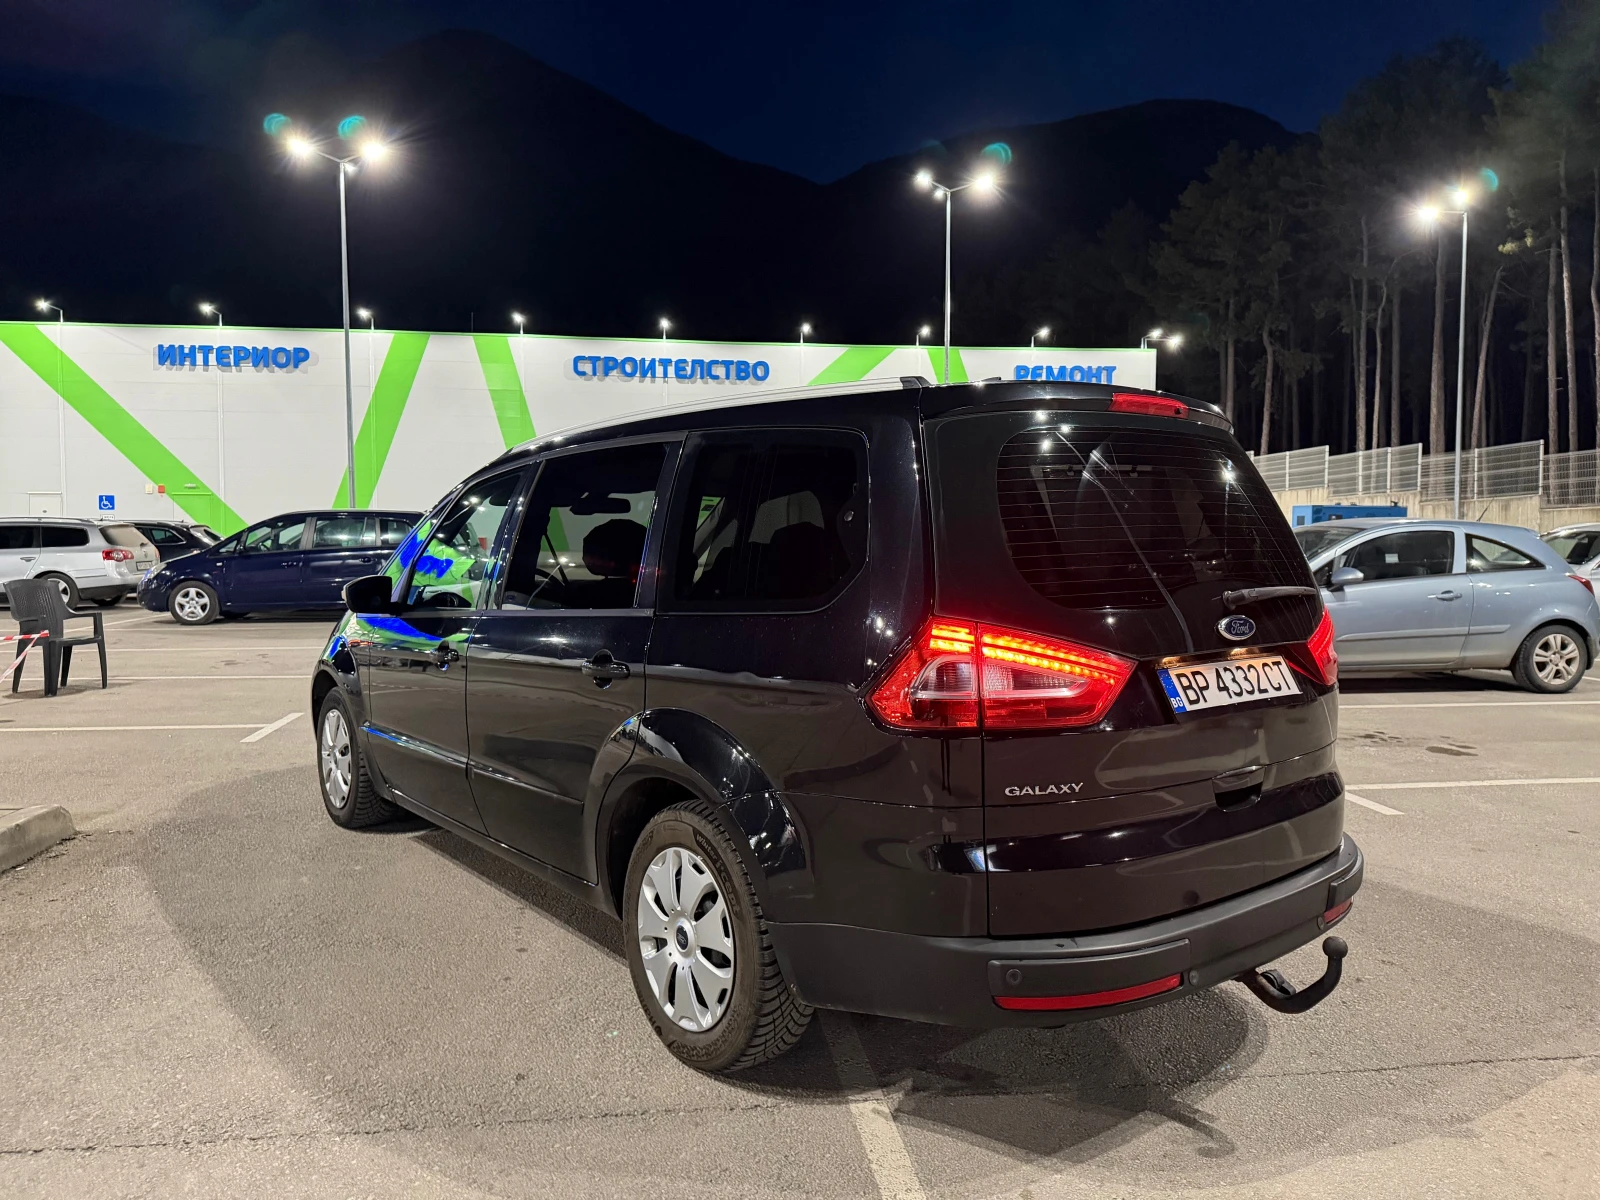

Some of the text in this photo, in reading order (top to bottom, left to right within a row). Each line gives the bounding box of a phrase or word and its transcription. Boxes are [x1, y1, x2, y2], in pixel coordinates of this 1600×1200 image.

[157, 344, 310, 369] ИНТЕРИОР
[572, 355, 770, 382] СТРОИТЕЛСТВО
[1014, 365, 1117, 385] РЕМОНТ
[1230, 619, 1250, 635] Ford
[1174, 669, 1210, 706] BP
[1170, 696, 1184, 709] BG
[1004, 782, 1084, 797] GALAXY
